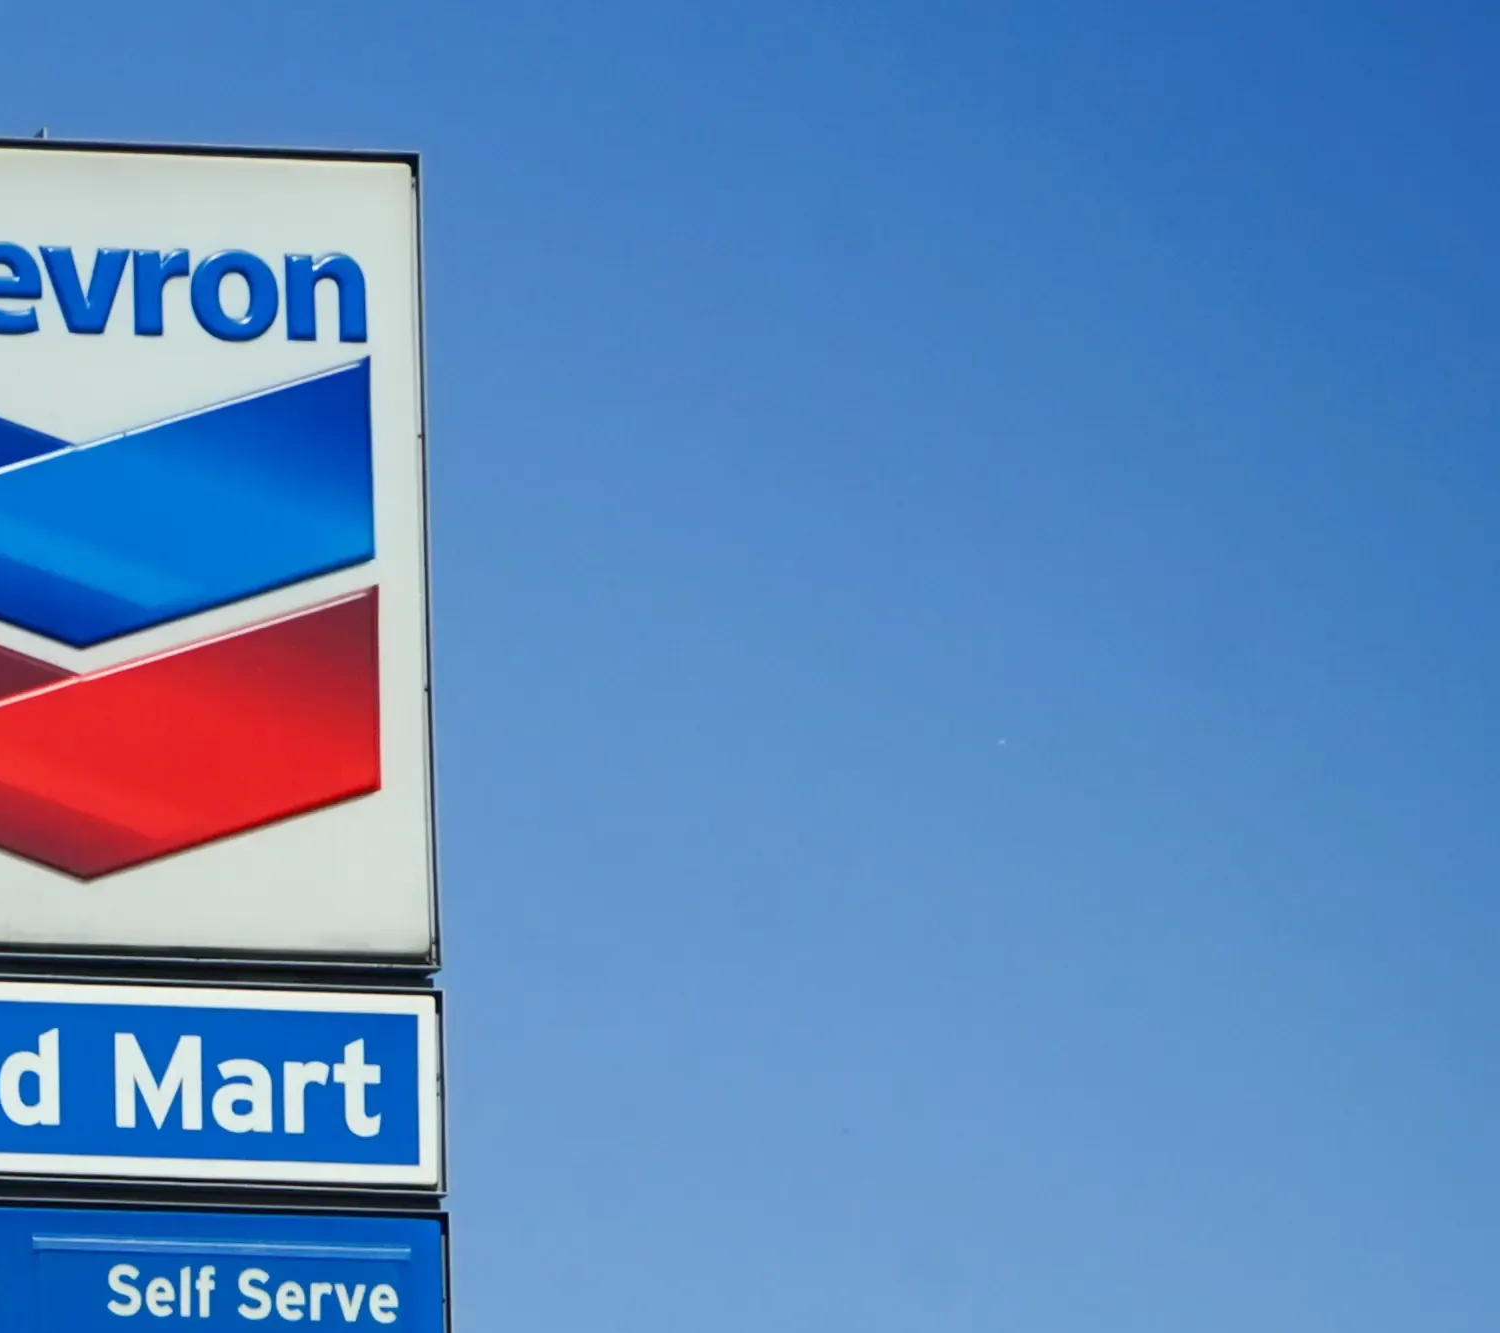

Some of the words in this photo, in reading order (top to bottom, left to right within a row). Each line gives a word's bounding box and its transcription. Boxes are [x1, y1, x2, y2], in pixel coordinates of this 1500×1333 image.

[113, 1031, 383, 1139] Mart
[107, 1264, 216, 1320] Self
[238, 1268, 400, 1324] Serve
